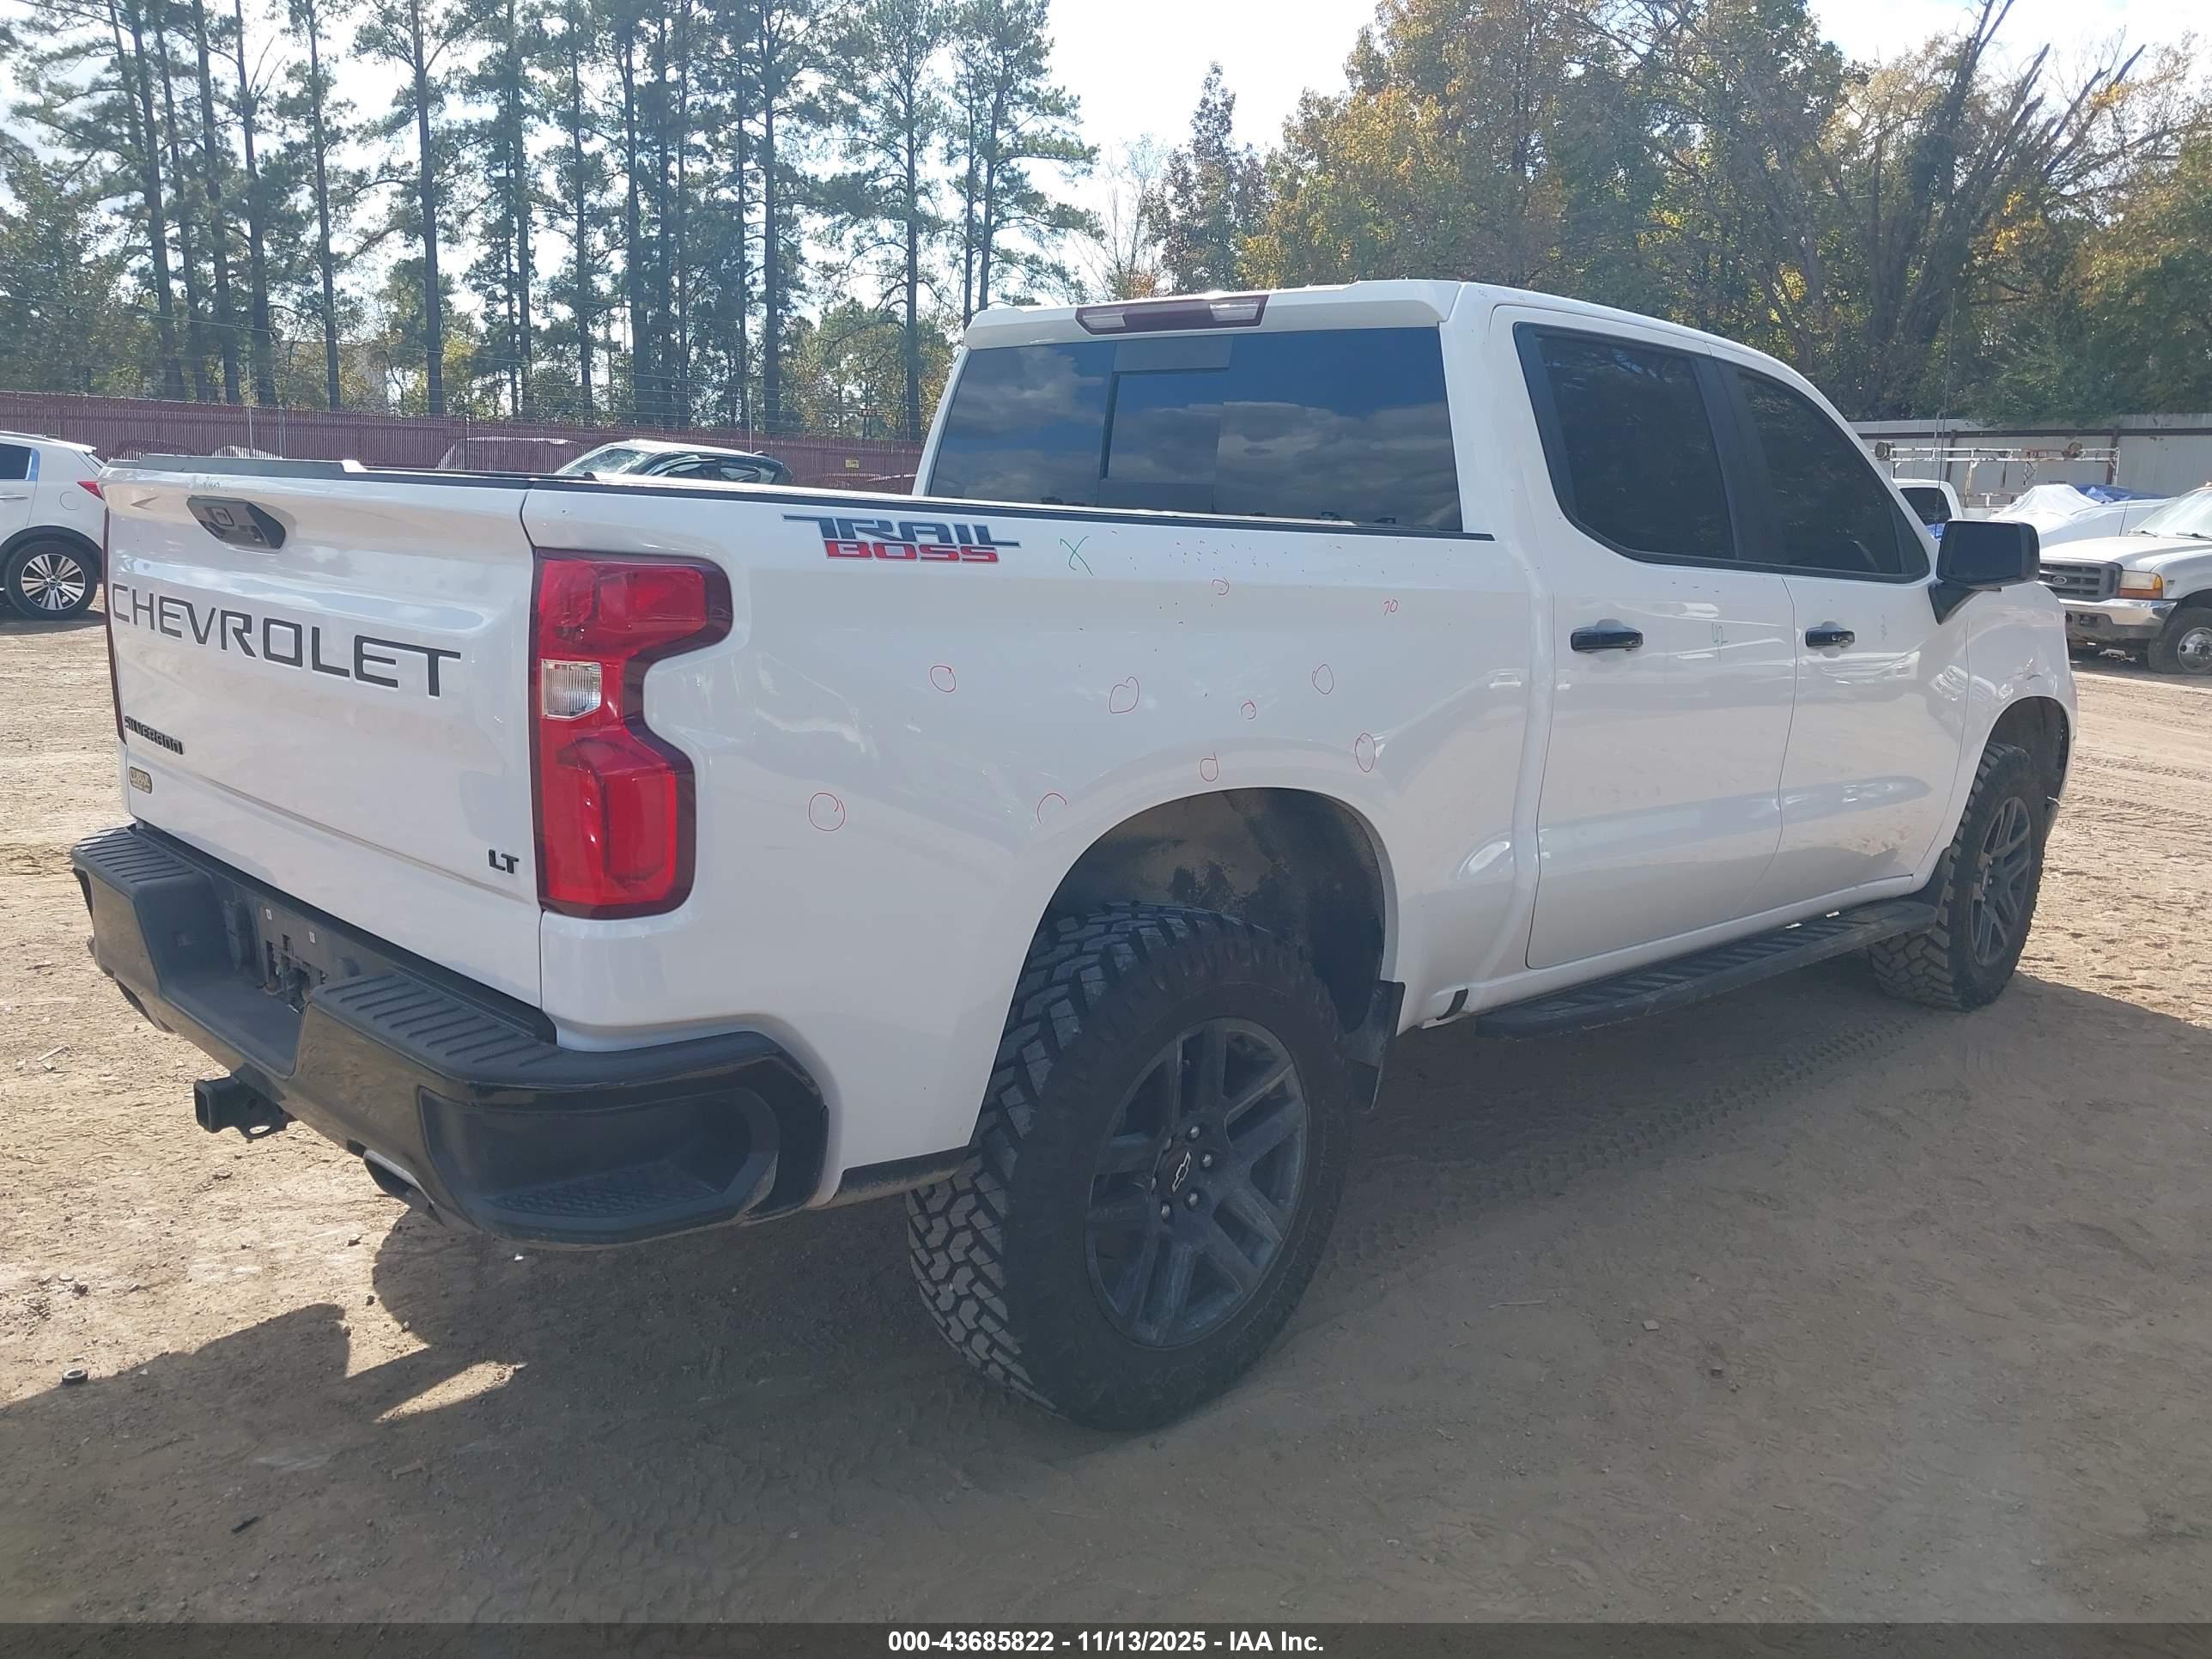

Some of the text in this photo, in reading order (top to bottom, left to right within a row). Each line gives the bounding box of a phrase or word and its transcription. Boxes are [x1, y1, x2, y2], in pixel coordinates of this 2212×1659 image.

[782, 514, 1020, 547] TRAIL
[824, 540, 999, 564] BOSS
[111, 584, 461, 698] CHEVROLET
[124, 714, 184, 755] SILVERADO
[488, 848, 520, 874] LT
